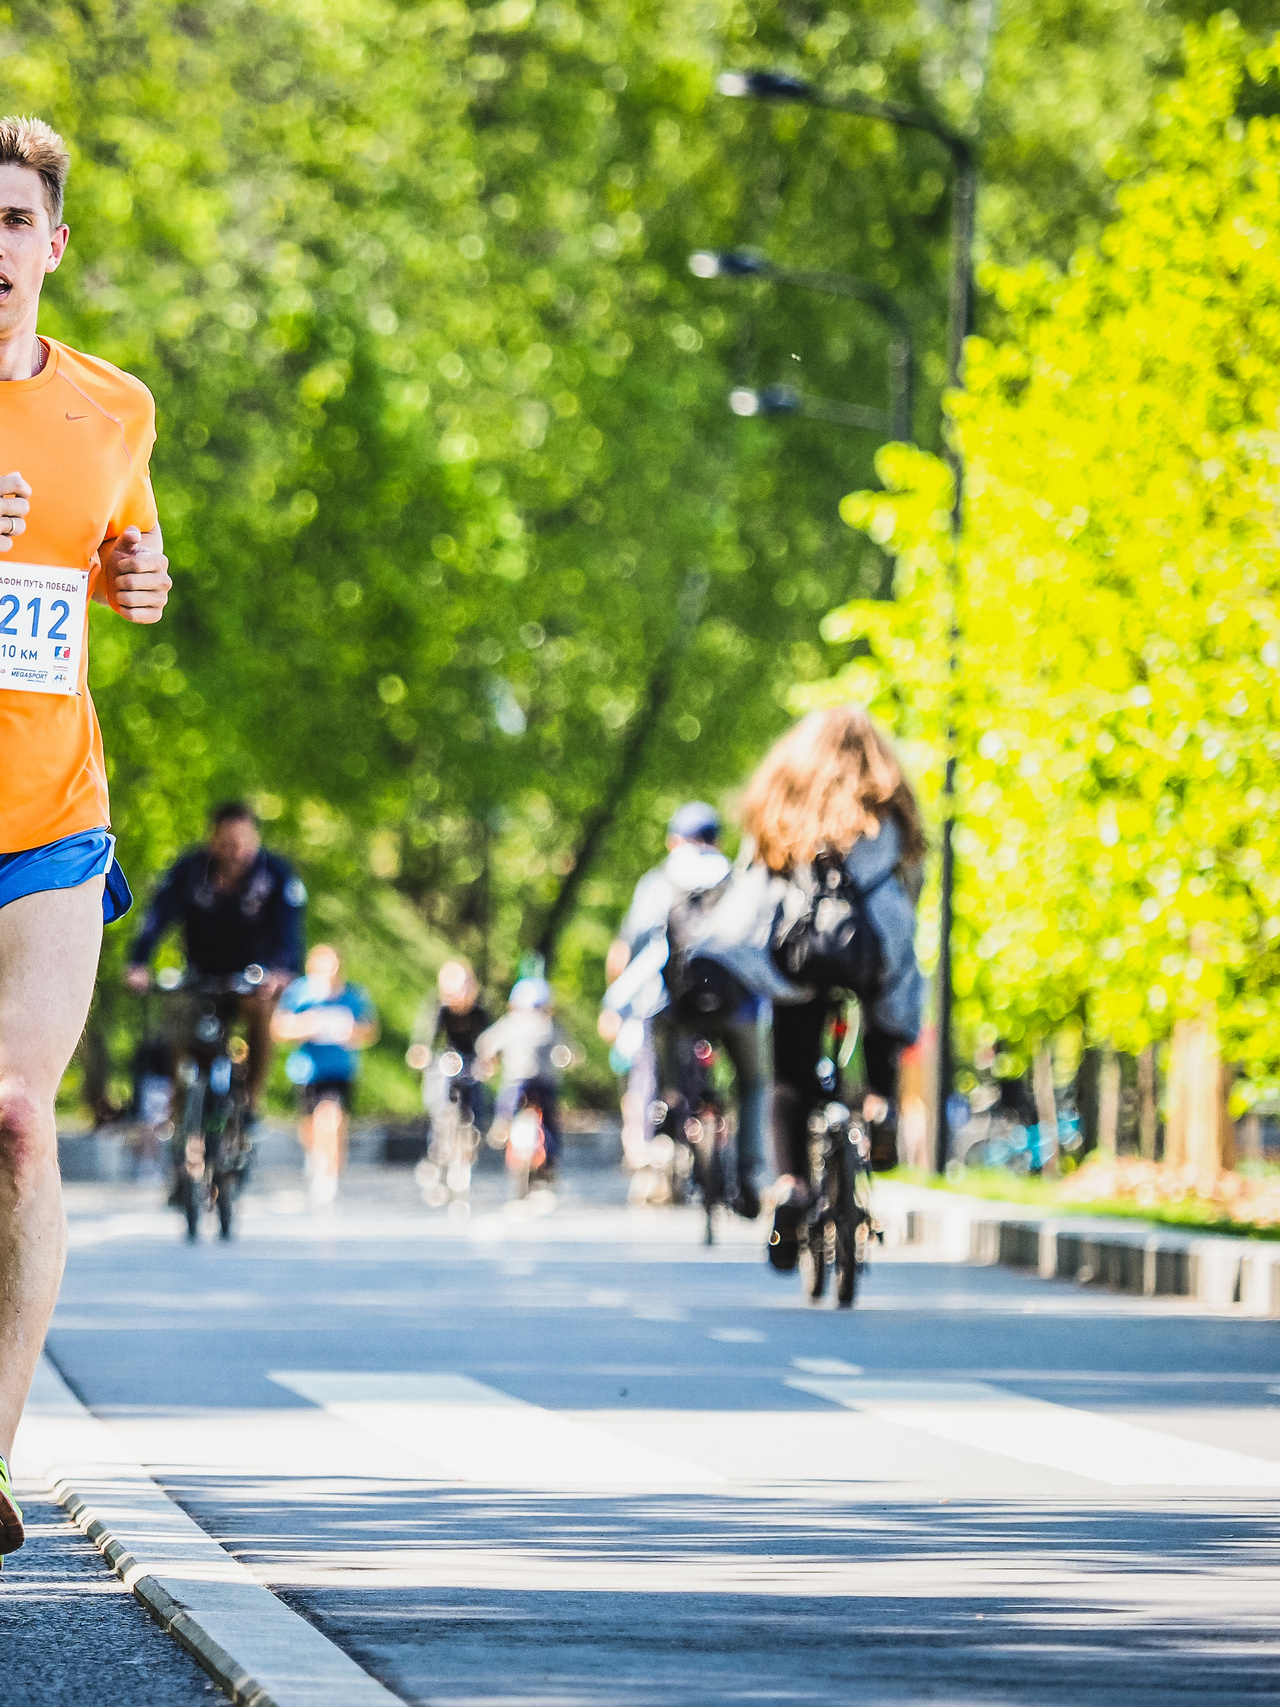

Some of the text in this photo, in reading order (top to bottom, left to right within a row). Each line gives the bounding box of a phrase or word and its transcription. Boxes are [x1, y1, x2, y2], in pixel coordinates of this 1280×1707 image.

[23, 579, 43, 589] ПУТЬ
[45, 582, 78, 593] ПОБЕДЫ
[1, 644, 17, 658] 10
[11, 671, 48, 680] MEGASPORT
